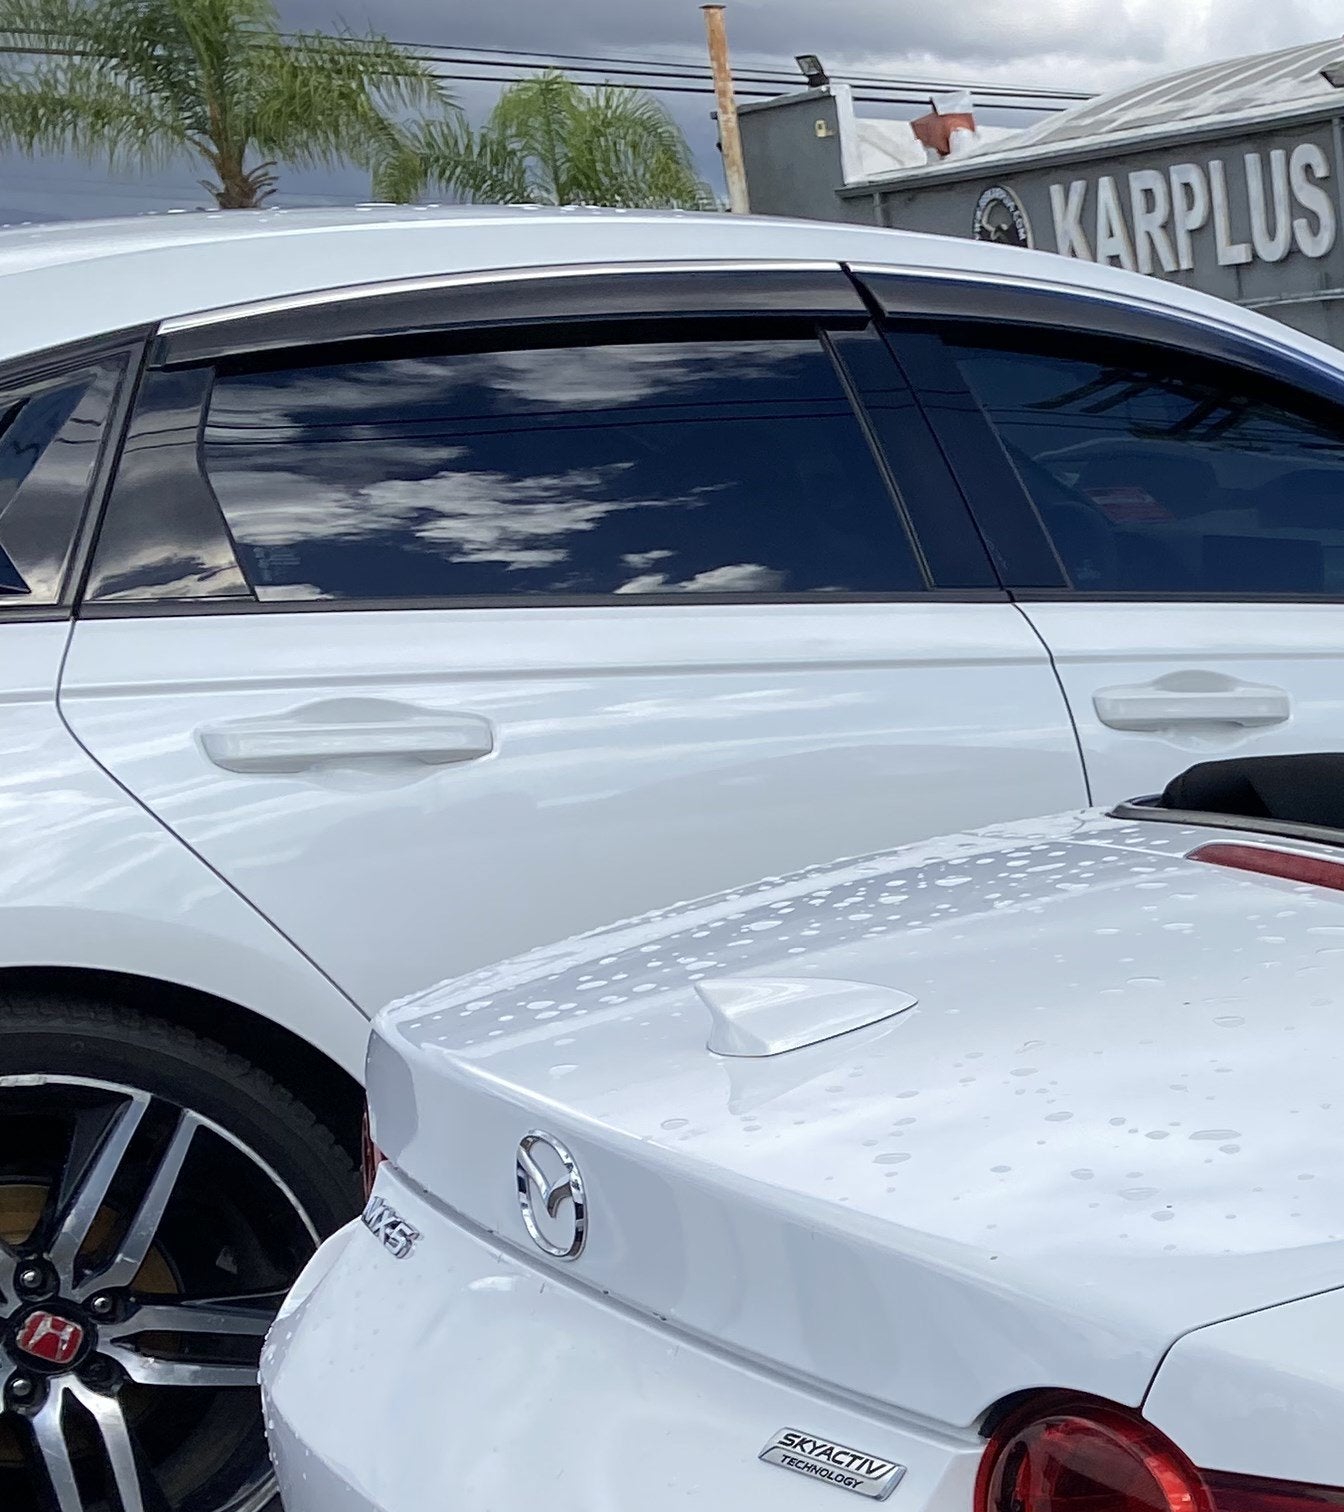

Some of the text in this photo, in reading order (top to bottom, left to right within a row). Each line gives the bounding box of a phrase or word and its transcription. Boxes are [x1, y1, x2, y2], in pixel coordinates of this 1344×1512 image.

[1049, 143, 1337, 275] KARPLUS
[777, 1432, 887, 1475] SKYACTIV
[781, 1454, 864, 1489] TECHNOLOGY
